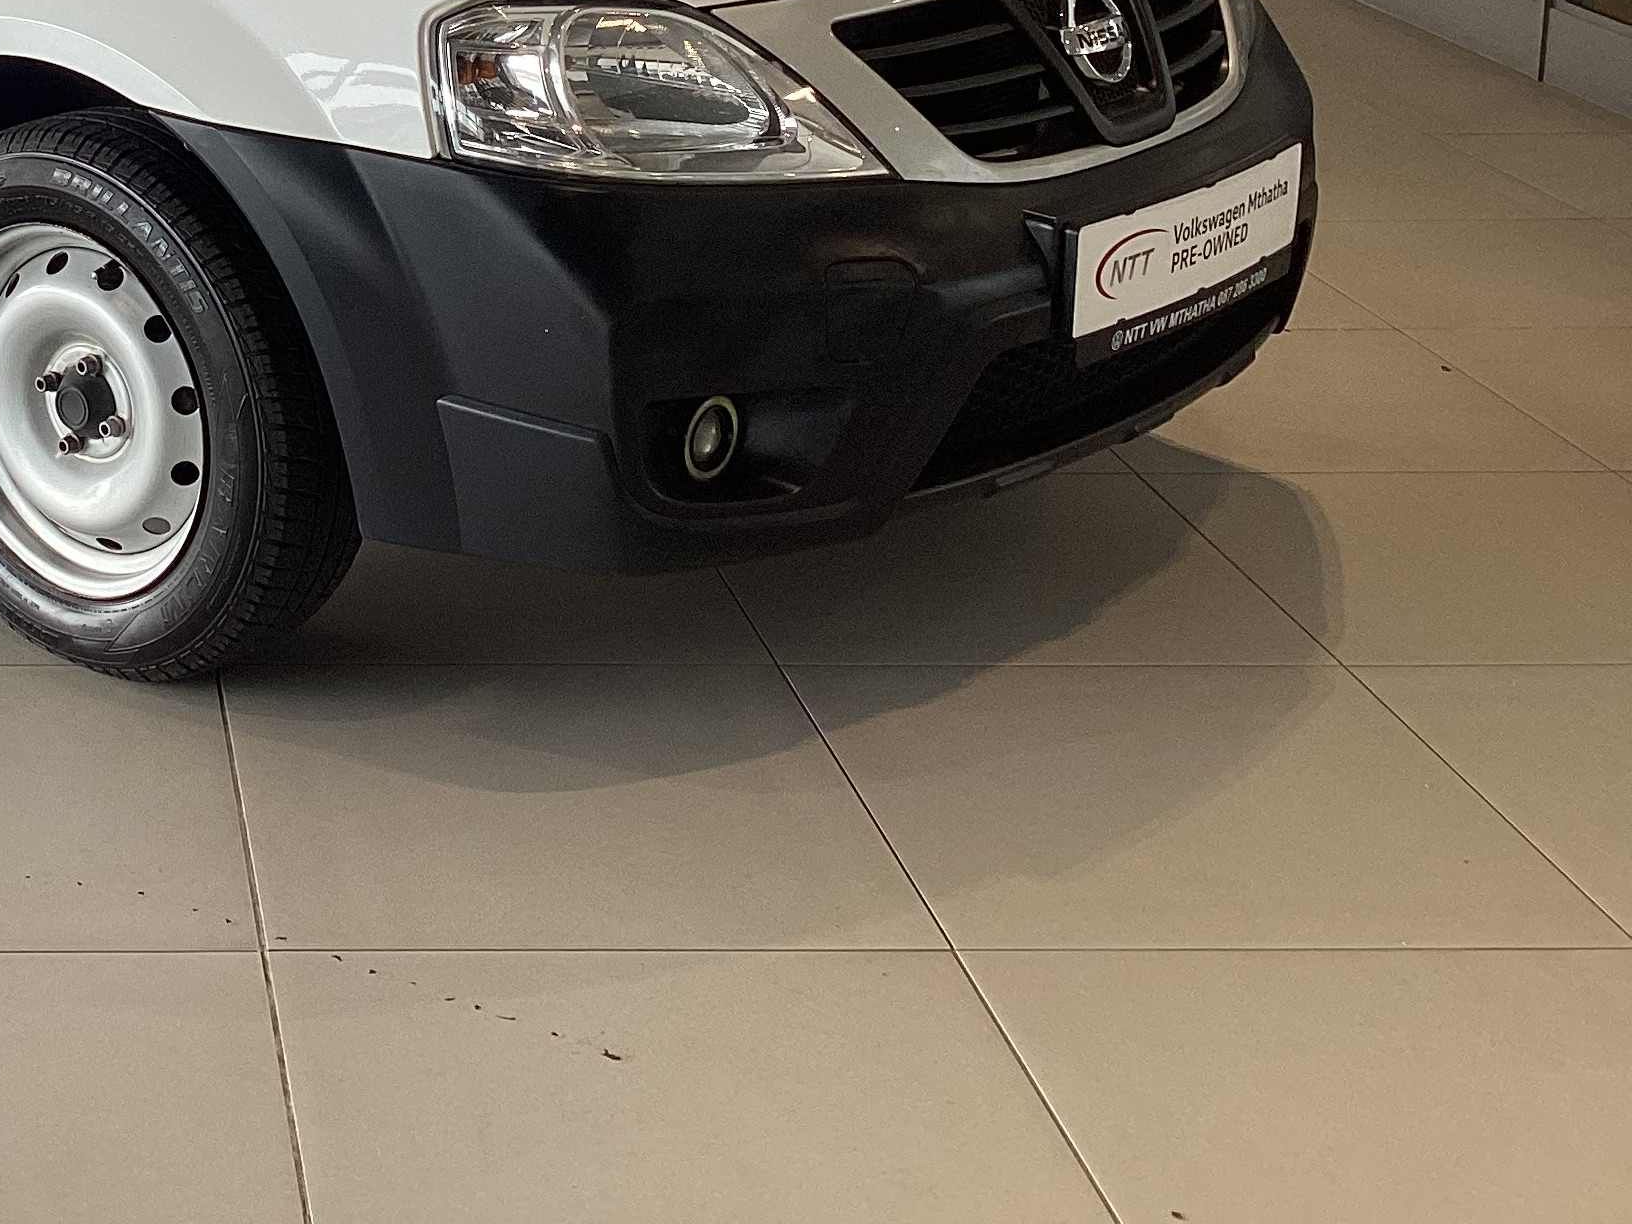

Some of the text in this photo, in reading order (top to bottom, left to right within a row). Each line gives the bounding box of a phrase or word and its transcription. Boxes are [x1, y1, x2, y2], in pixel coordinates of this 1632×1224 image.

[1174, 178, 1289, 244] Volkswagen Mthatha
[1109, 247, 1156, 287] NTT
[1170, 222, 1249, 274] PRE-OWNED
[1123, 322, 1149, 345] NTT
[1149, 315, 1169, 336] VW
[1168, 295, 1217, 329] MTHATHA
